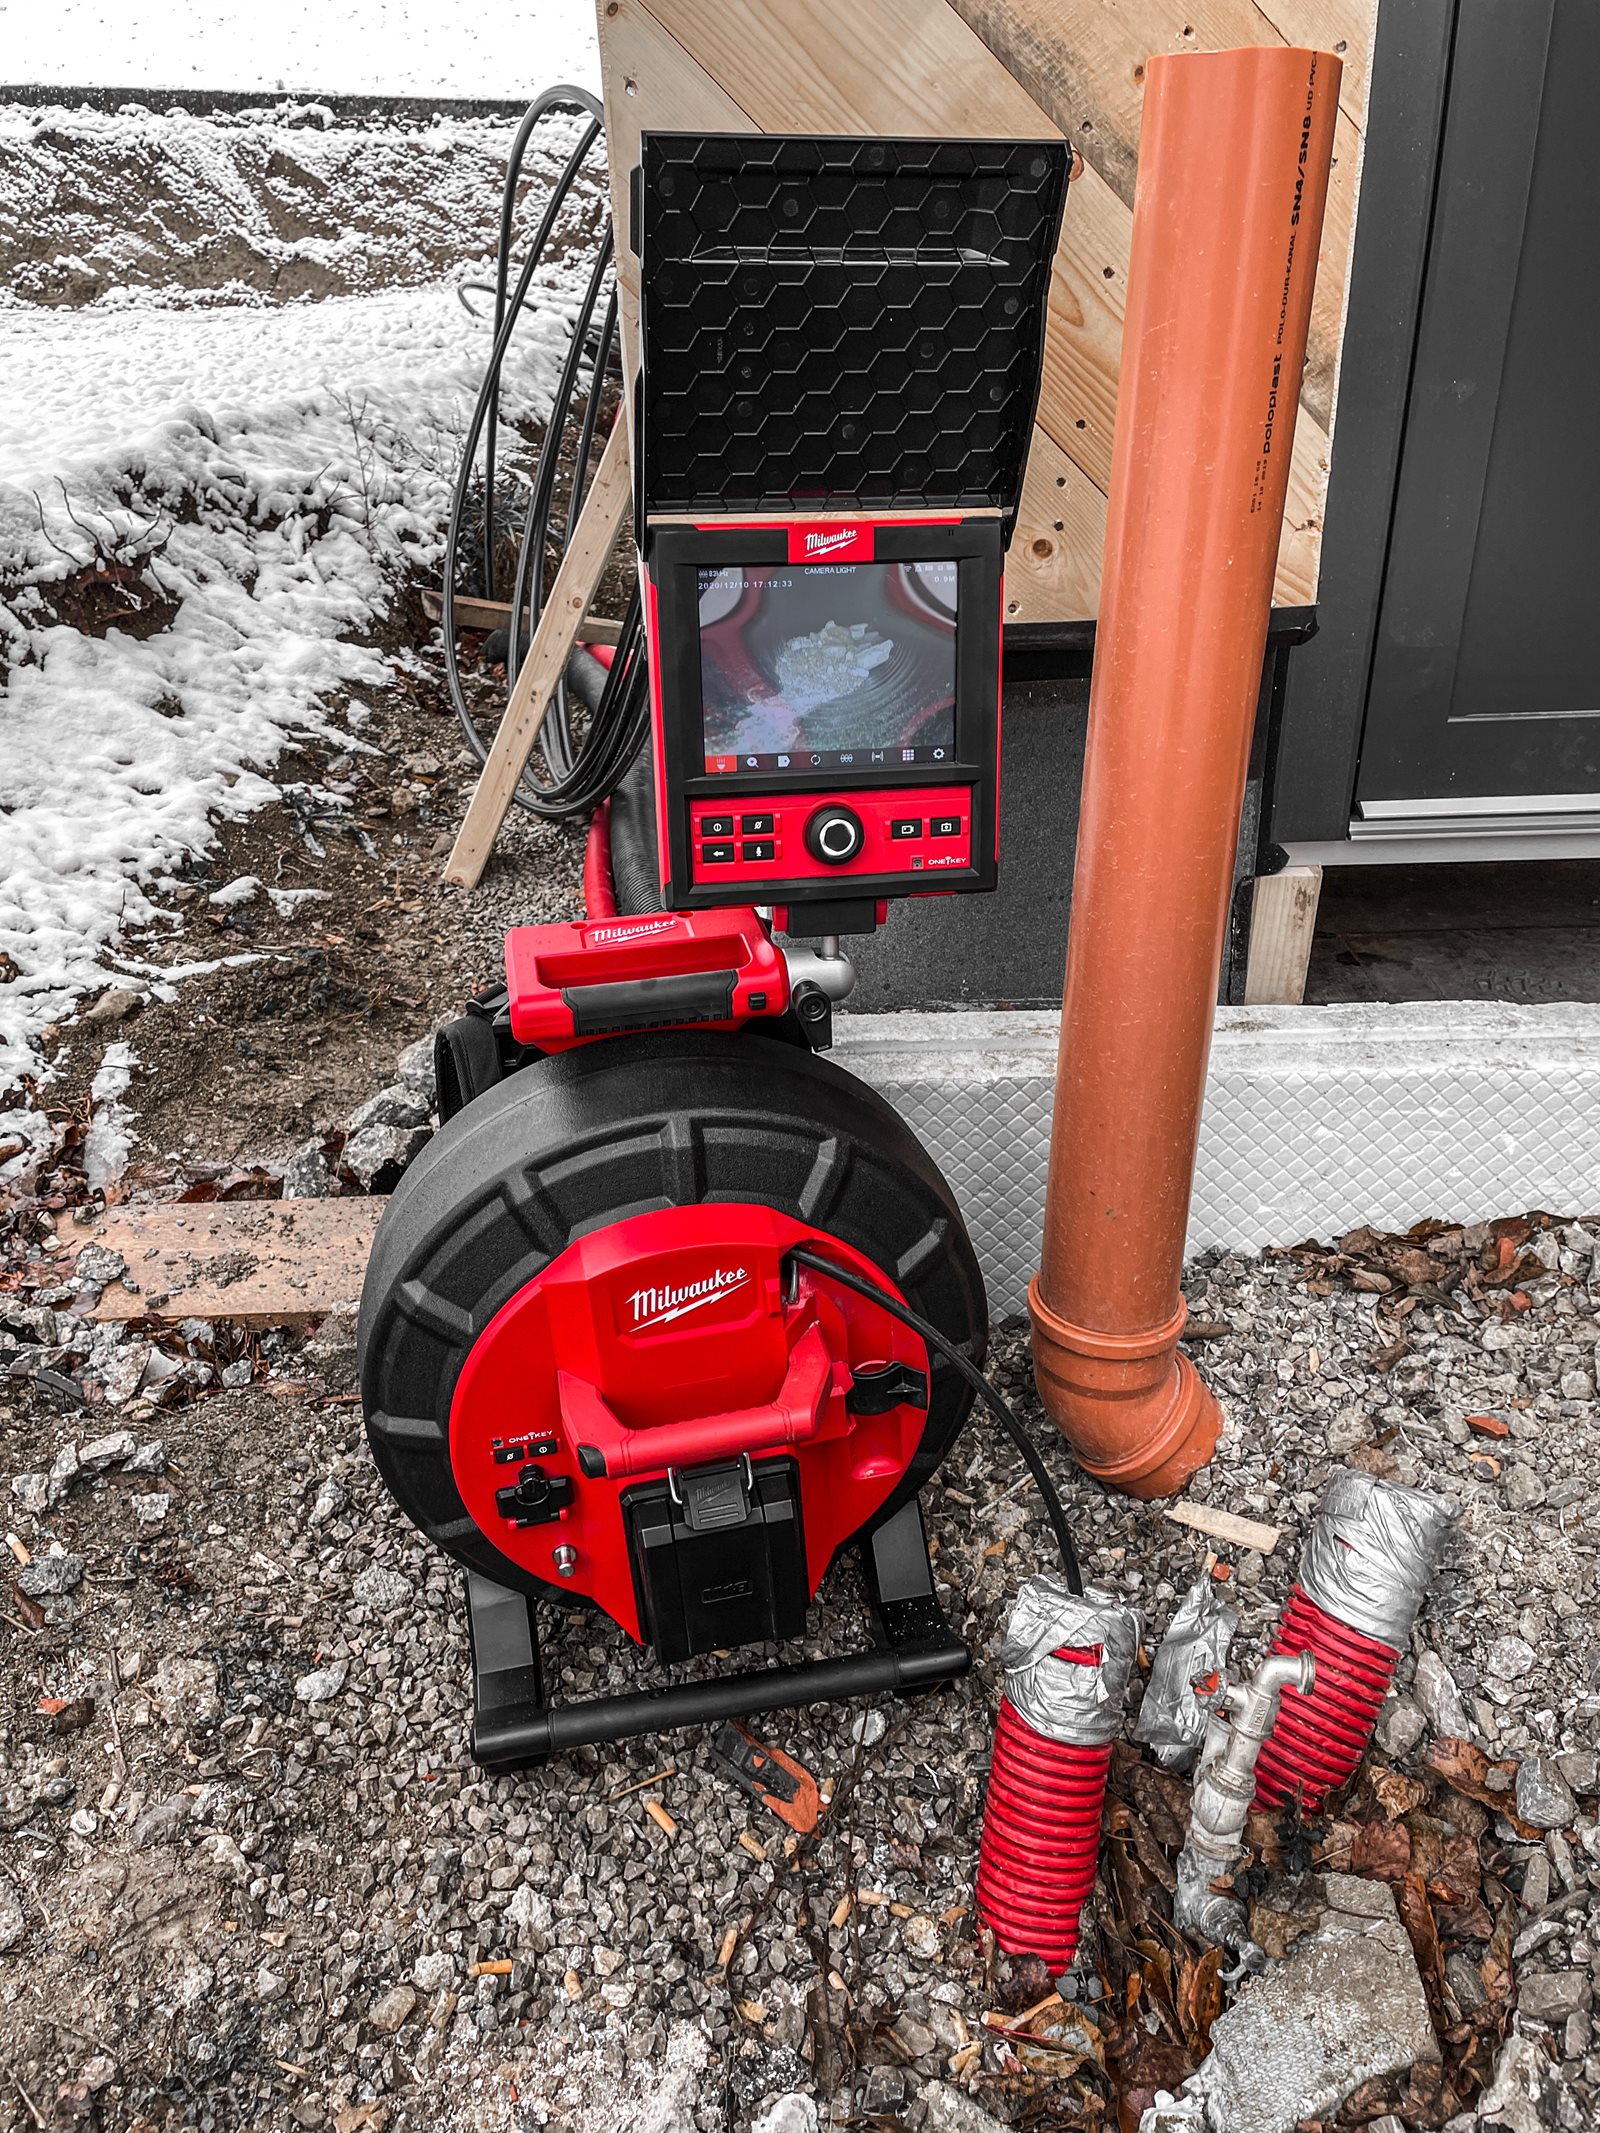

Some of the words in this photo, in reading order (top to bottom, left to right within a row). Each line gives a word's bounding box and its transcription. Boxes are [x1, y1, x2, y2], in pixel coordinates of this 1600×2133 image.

[1263, 354, 1282, 454] poloplast
[1277, 231, 1297, 345] POLO-DUR-KANAL
[1291, 115, 1311, 226] SN4/SN8
[1306, 90, 1314, 111] UD
[804, 528, 858, 551] Milwaukee
[836, 566, 857, 574] LIGHT
[698, 582, 749, 590] 2020/12/10
[753, 580, 793, 588] 17:12:33
[588, 919, 678, 943] Milwaukee
[625, 1266, 749, 1320] Milwaukee
